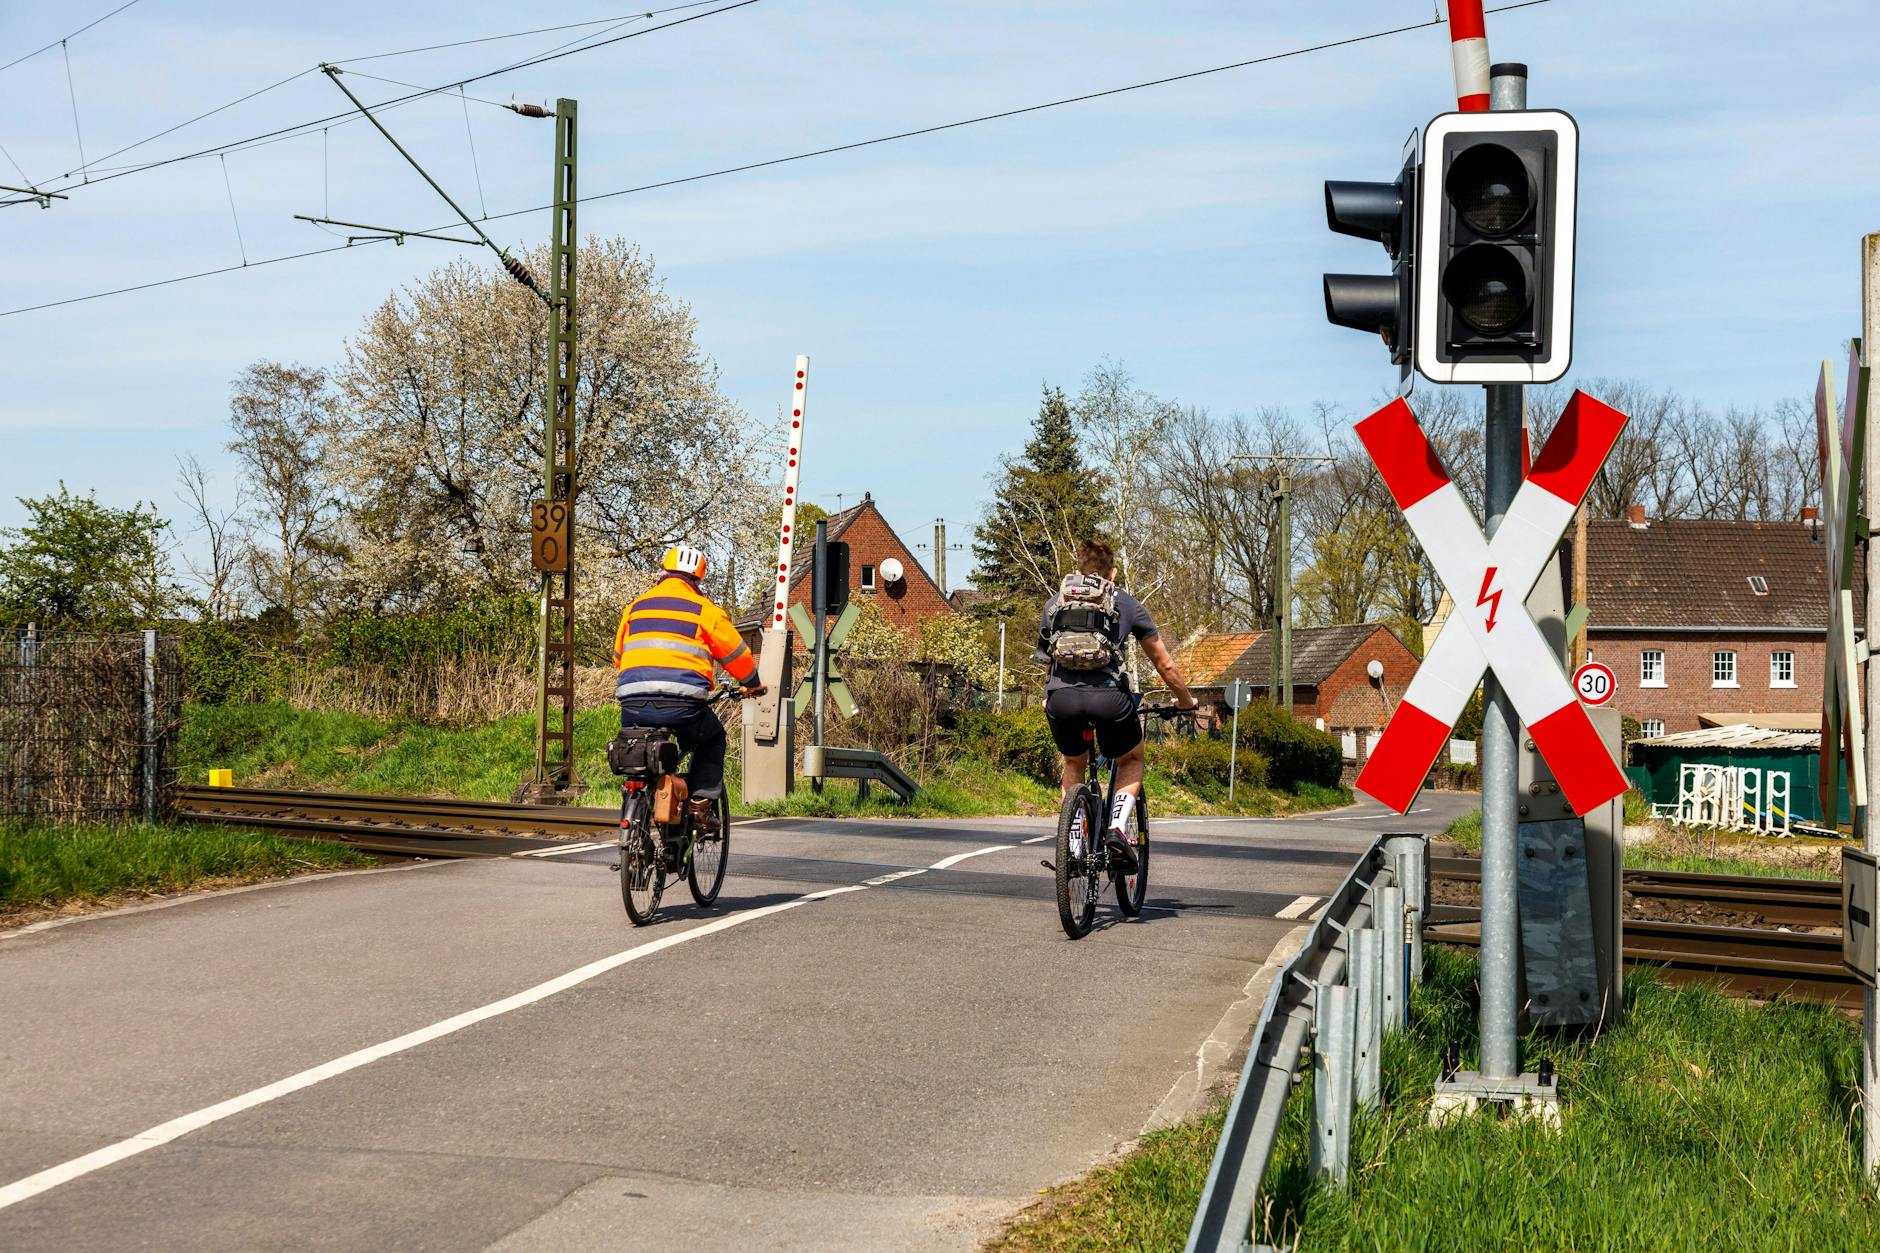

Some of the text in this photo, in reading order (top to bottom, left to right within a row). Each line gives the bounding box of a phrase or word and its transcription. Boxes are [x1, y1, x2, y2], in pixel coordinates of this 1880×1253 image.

[535, 504, 565, 533] 39
[541, 536, 559, 565] 0
[1582, 674, 1606, 694] 30
